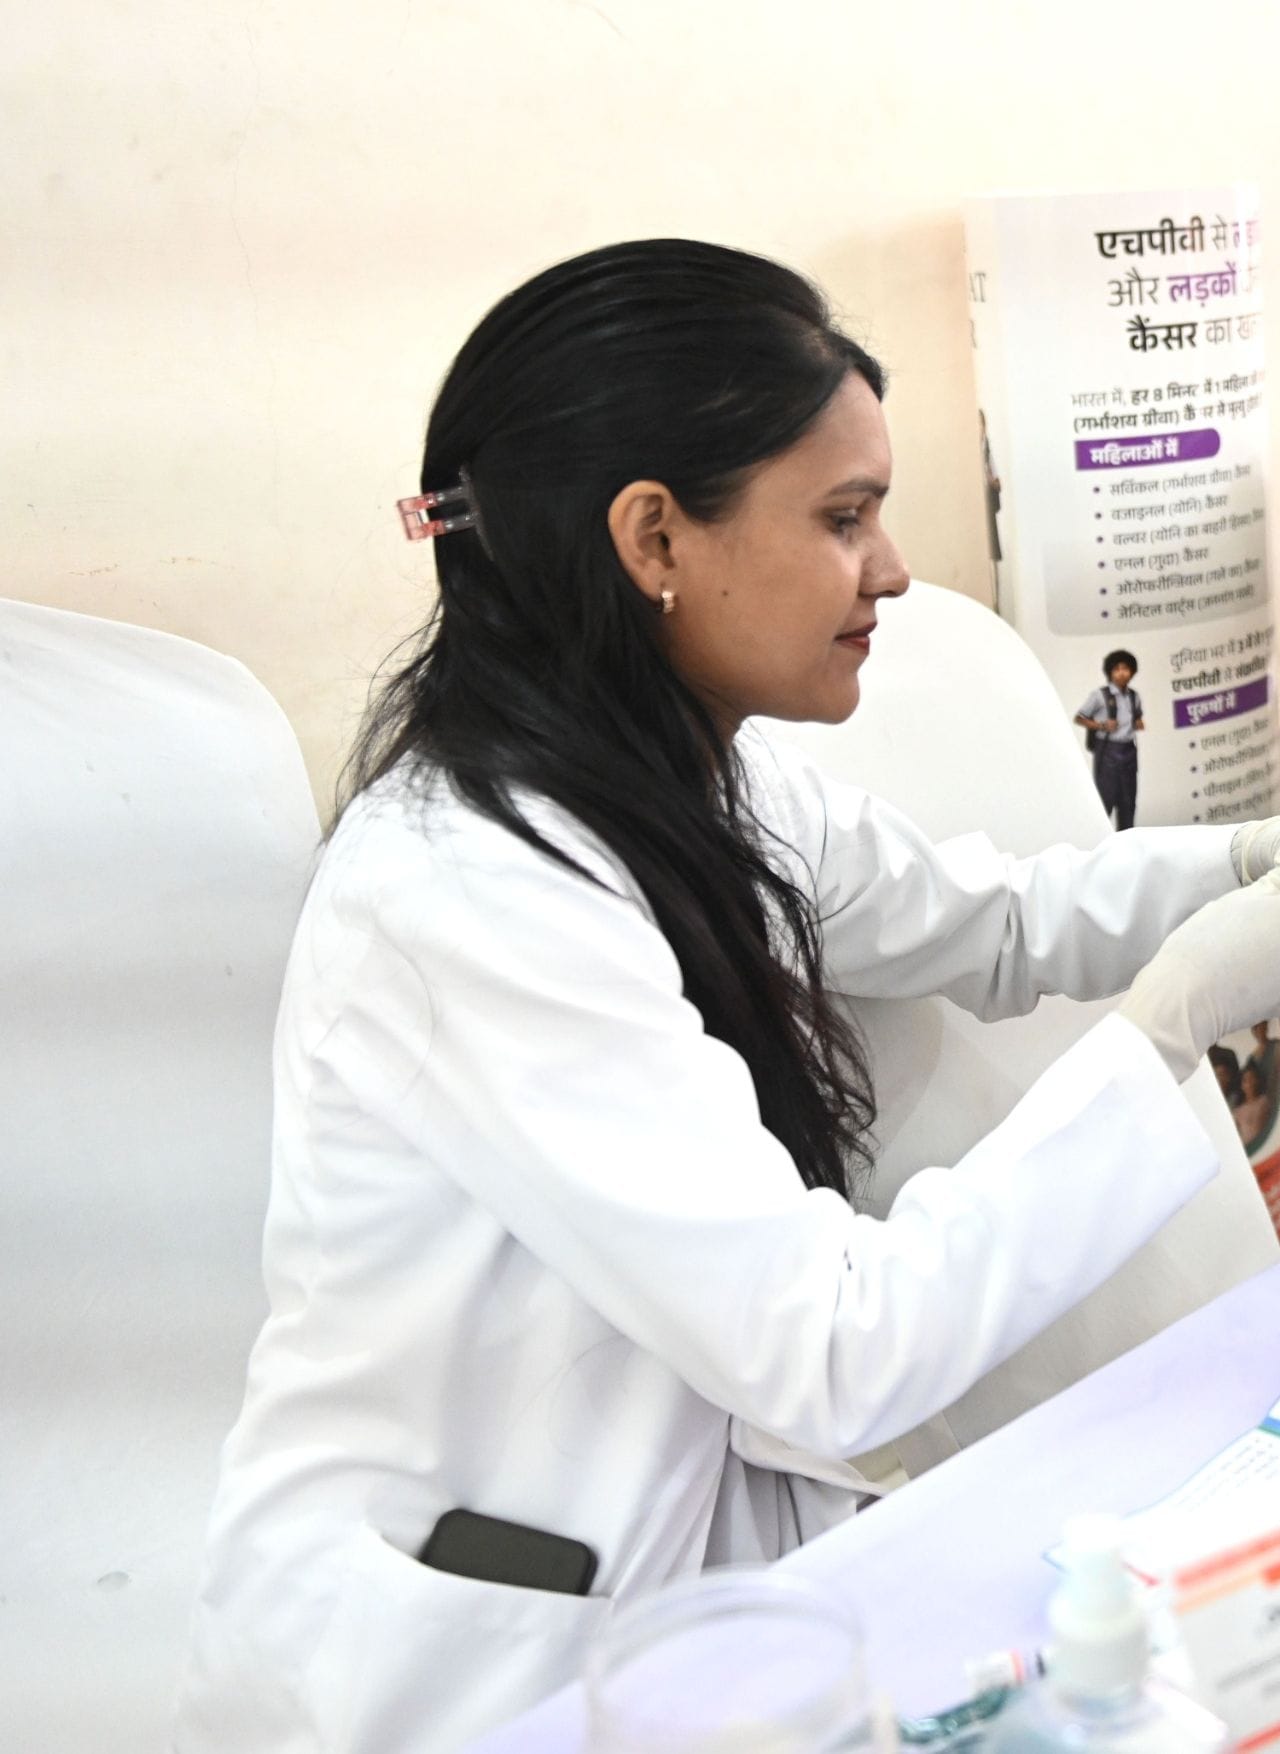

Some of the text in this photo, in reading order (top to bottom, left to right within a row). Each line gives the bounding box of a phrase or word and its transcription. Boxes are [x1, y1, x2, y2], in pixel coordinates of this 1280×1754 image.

[1094, 216, 1204, 258] एचपीवी
[1210, 214, 1228, 250] से
[1107, 267, 1160, 307] और
[1166, 261, 1237, 308] लड़कों
[1126, 315, 1198, 352] कैंसर
[1205, 317, 1232, 344] का
[1071, 391, 1107, 408] भारत
[1131, 388, 1149, 406] हर
[1153, 388, 1163, 402] 8
[1073, 411, 1138, 434] (गर्भाशय
[1142, 407, 1180, 427] ग्रीवा)
[1090, 436, 1180, 465] महिलाओं में
[1171, 667, 1221, 693] एचपीवी
